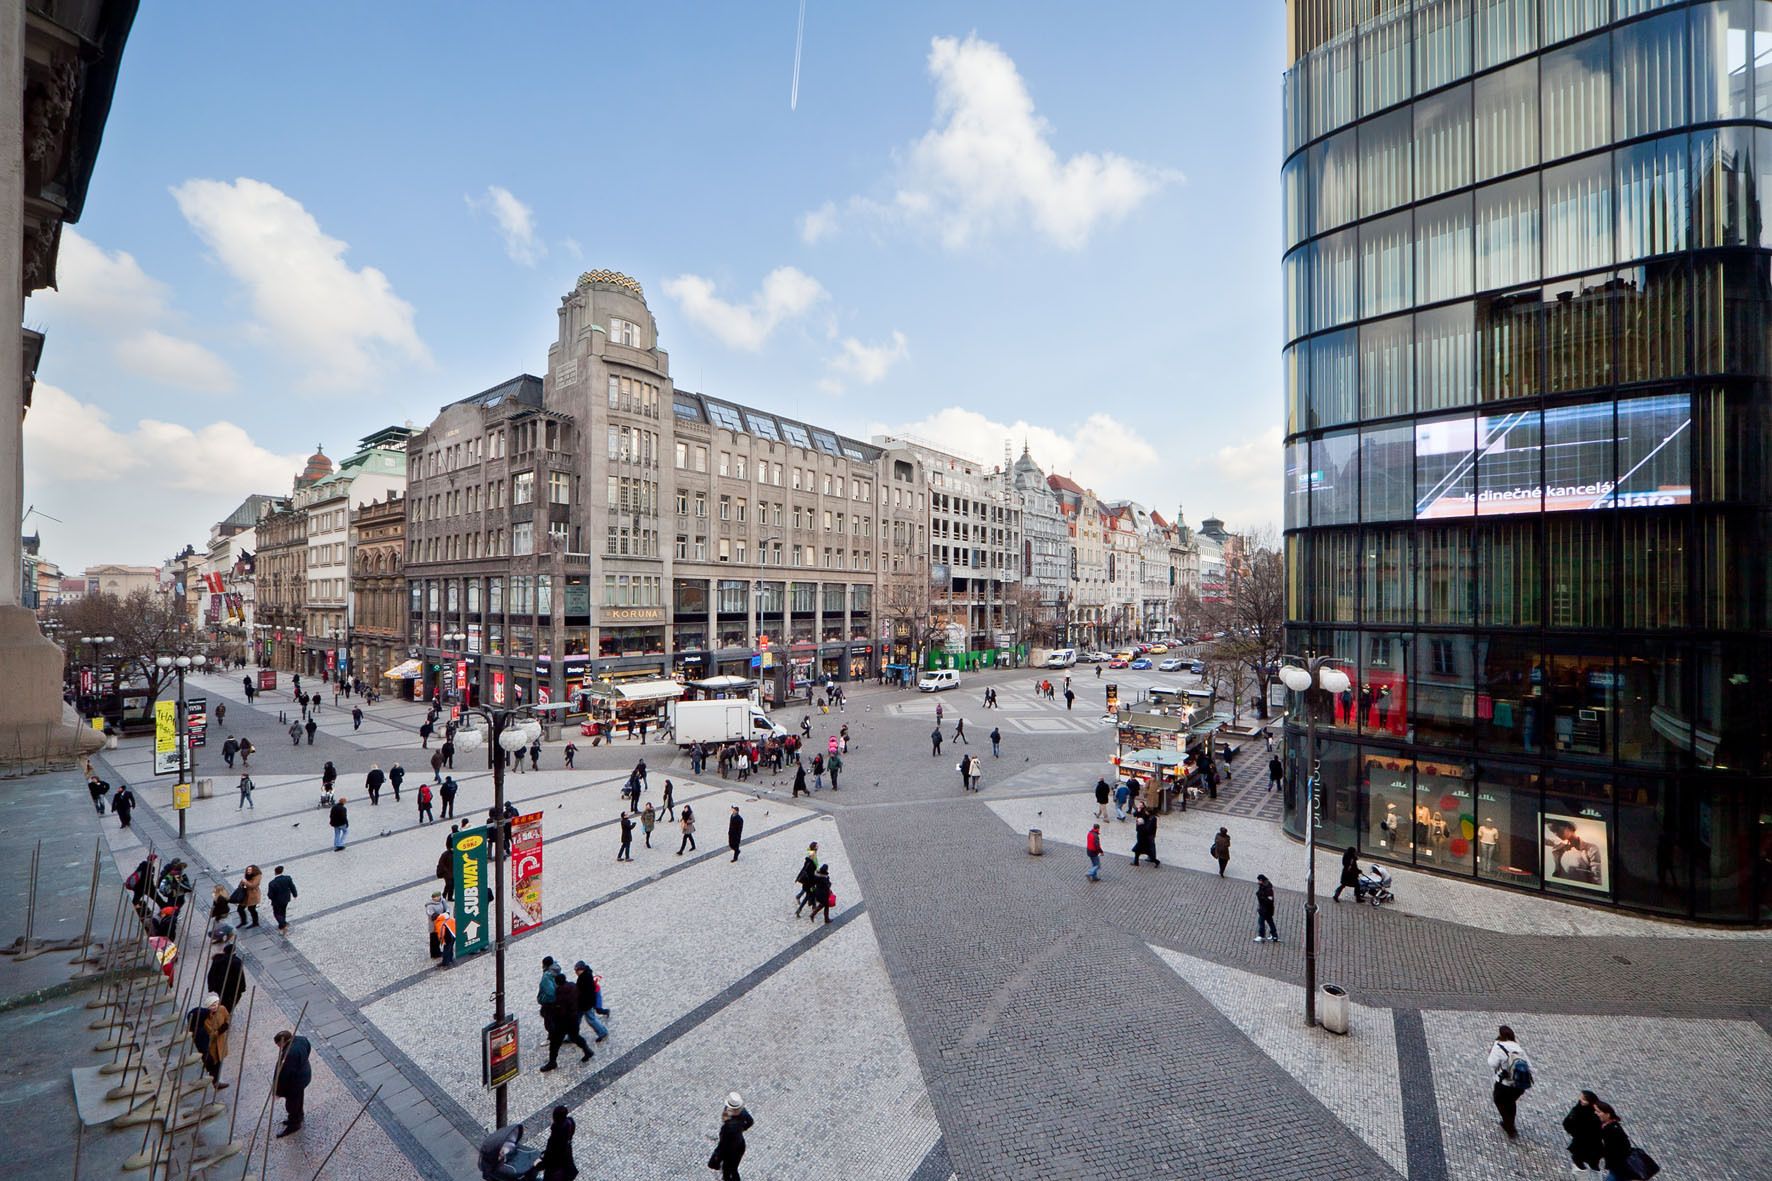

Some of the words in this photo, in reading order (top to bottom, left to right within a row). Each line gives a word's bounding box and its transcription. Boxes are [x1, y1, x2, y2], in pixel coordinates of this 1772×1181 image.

[1463, 486, 1542, 503] Jedinečné
[612, 610, 658, 618] KORUNA
[463, 853, 479, 917] SUBWAY
